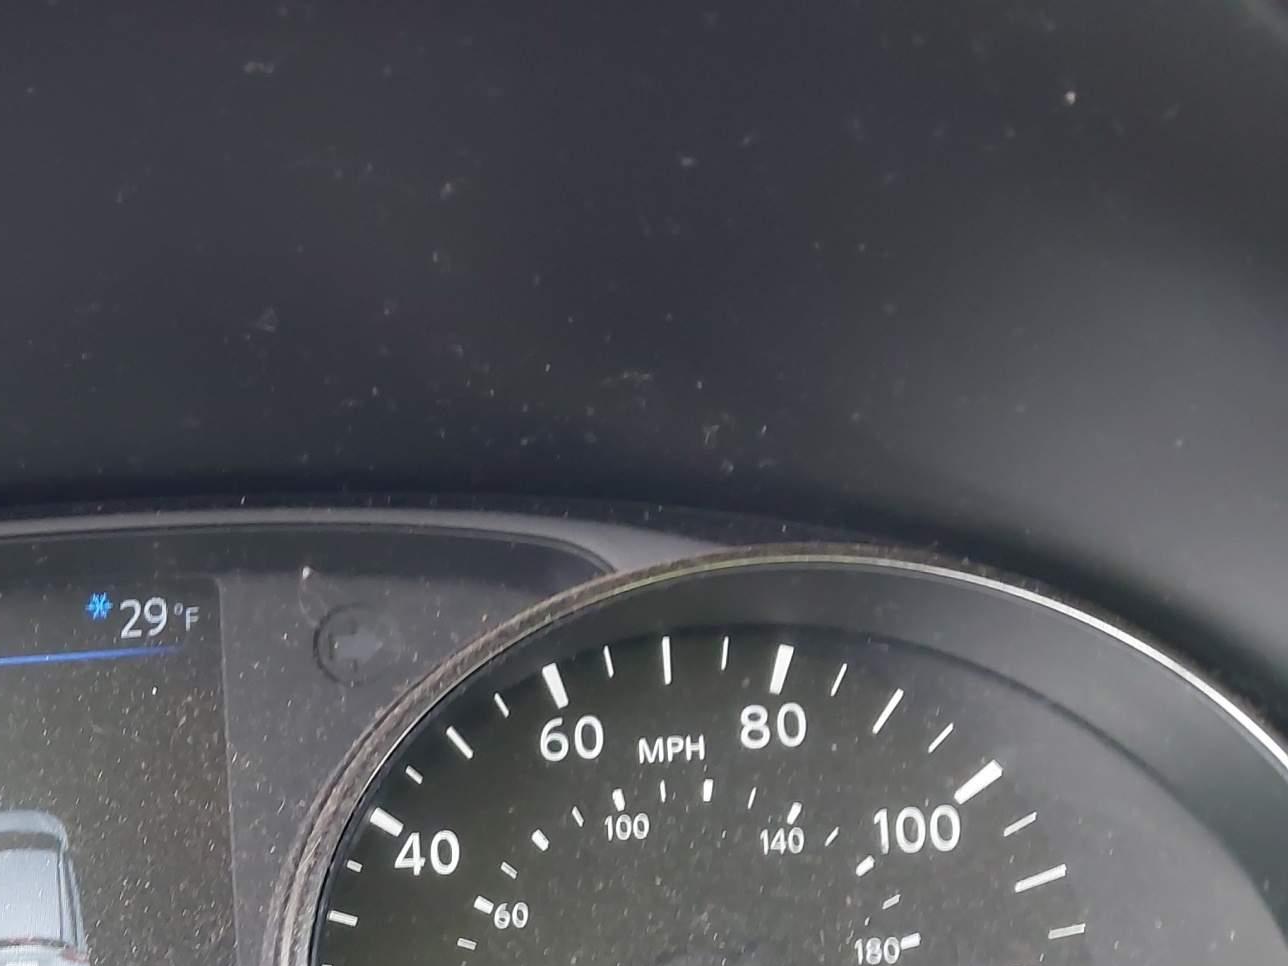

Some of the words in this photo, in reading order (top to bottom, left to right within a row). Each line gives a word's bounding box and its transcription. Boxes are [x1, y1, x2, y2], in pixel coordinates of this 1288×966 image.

[540, 715, 603, 761] 60
[740, 702, 806, 749] 80
[638, 735, 705, 764] MPH
[605, 813, 650, 840] 100
[760, 827, 804, 854] 140
[873, 804, 960, 854] 100
[394, 830, 460, 874] 40
[493, 902, 528, 928] 60
[855, 936, 900, 965] 180
